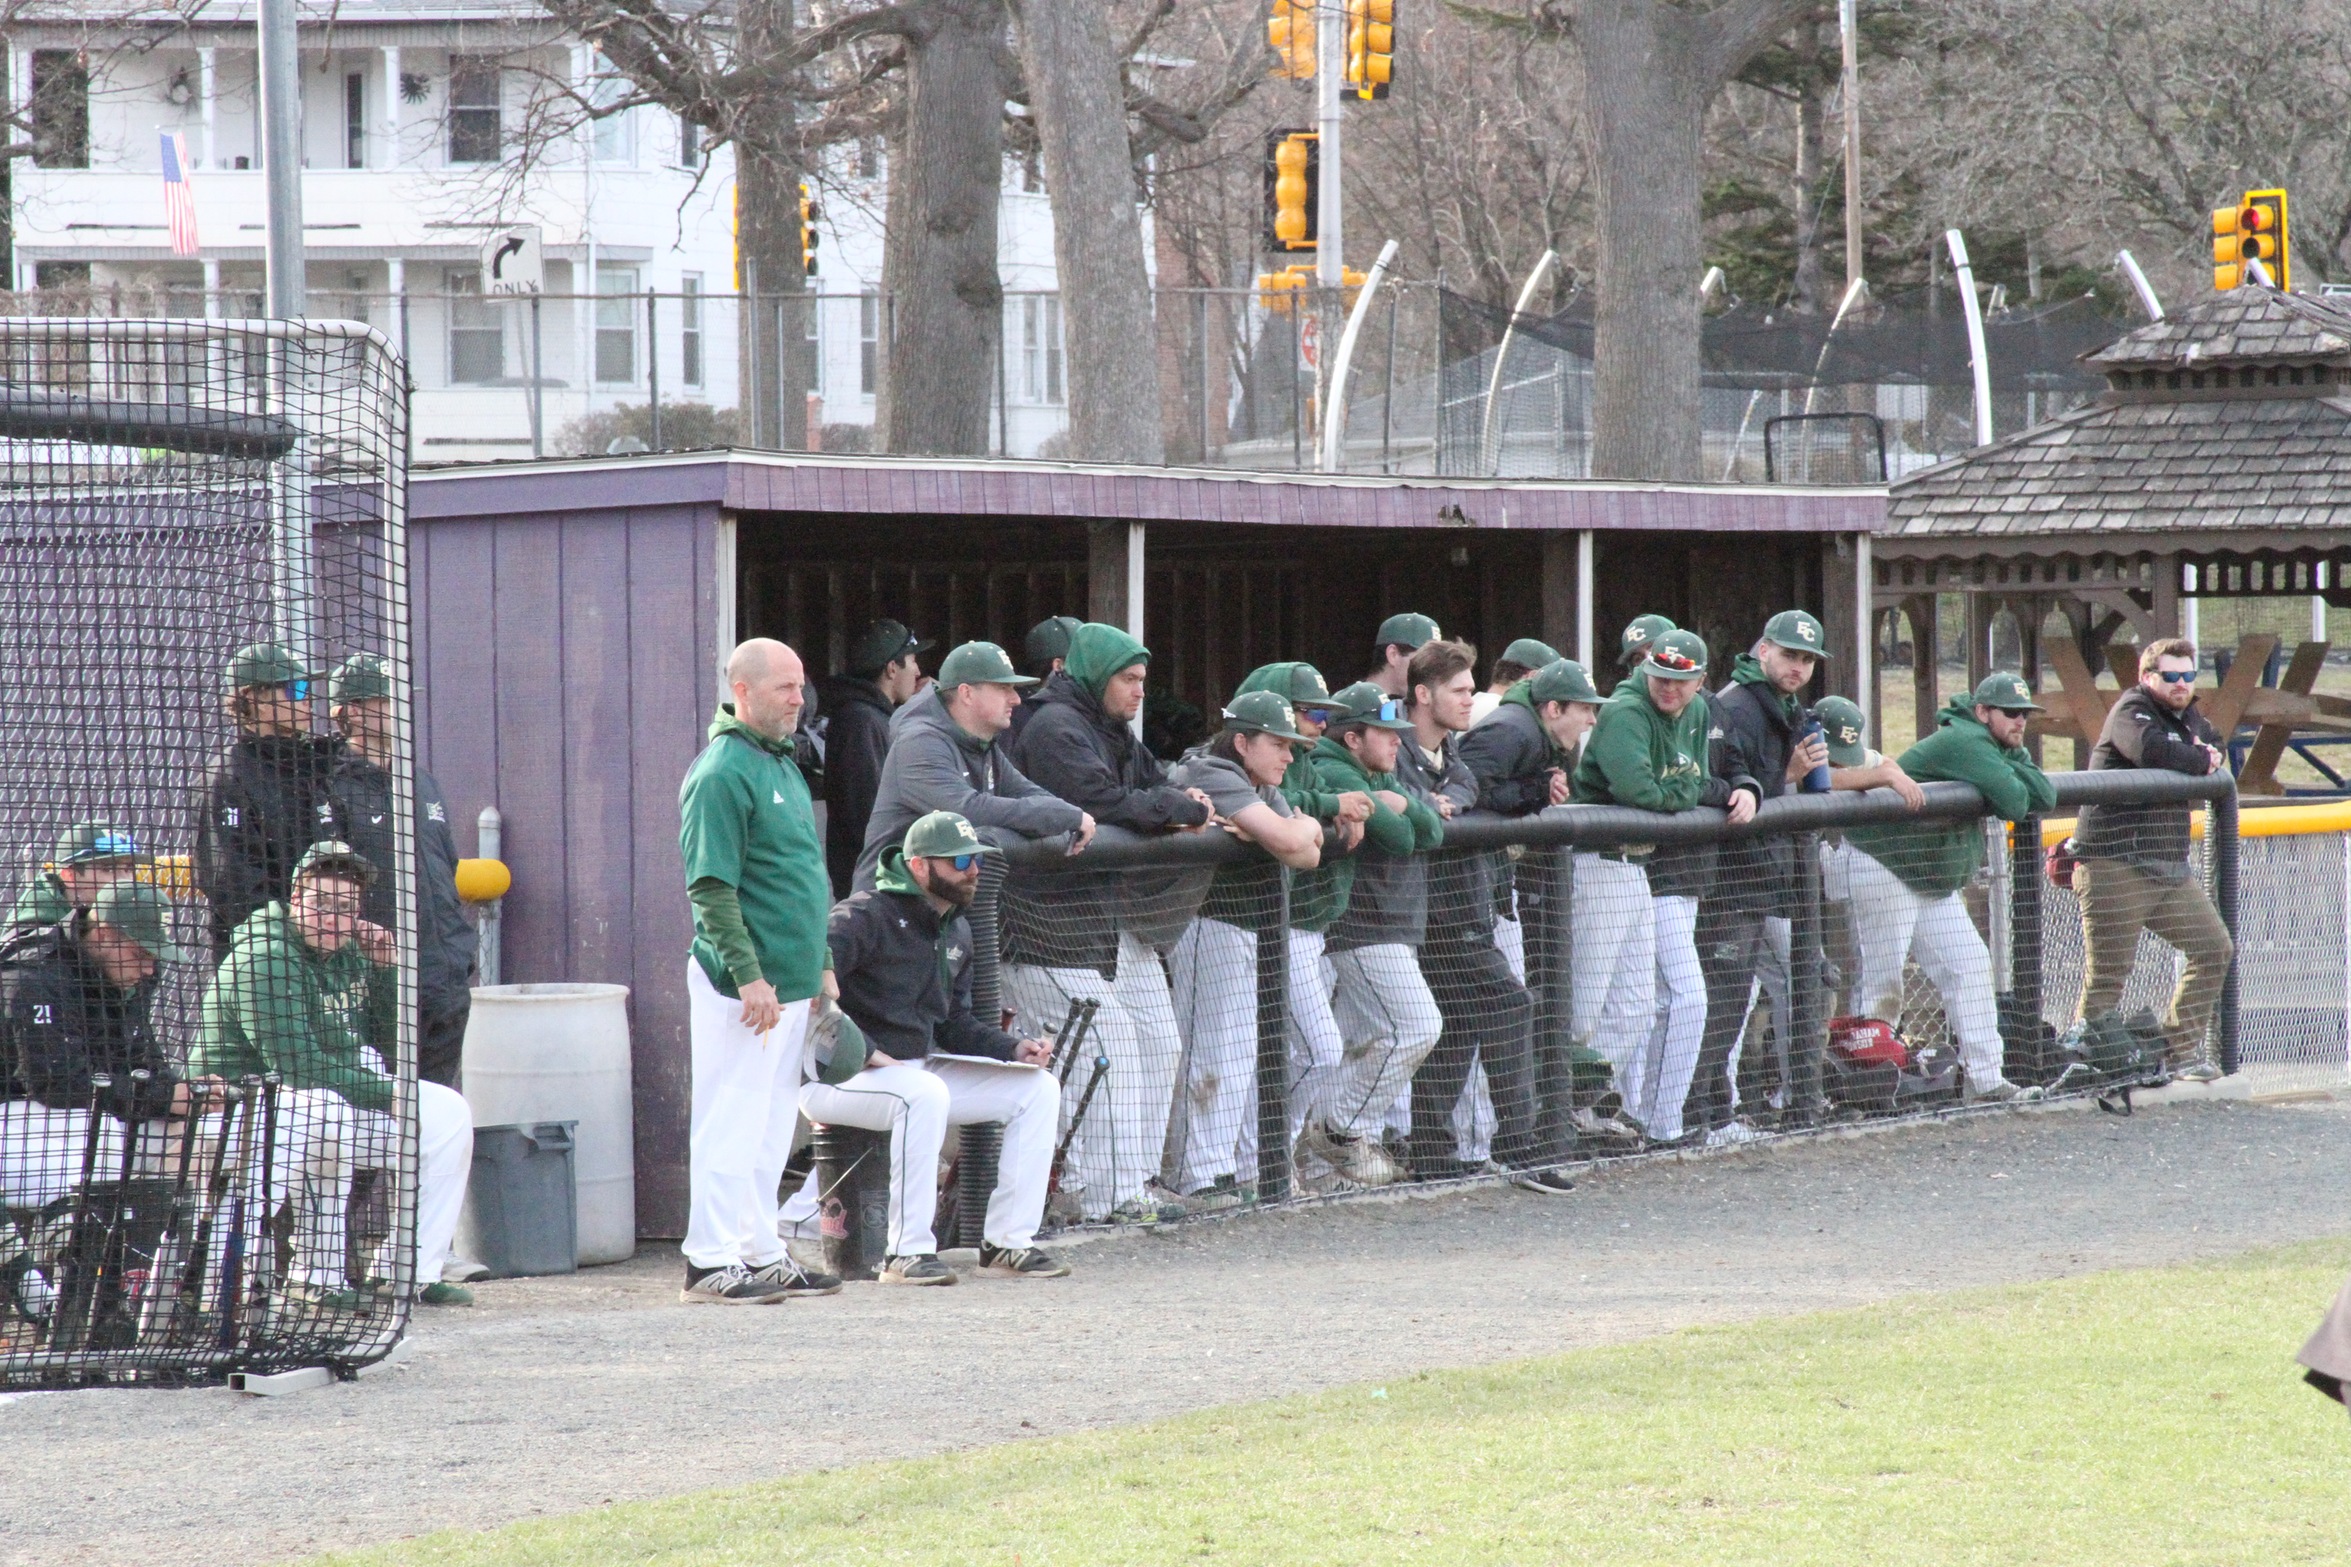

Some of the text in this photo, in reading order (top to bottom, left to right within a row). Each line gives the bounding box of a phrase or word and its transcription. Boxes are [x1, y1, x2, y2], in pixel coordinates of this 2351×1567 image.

[1626, 626, 1646, 642] EC
[1796, 621, 1815, 642] EC
[2013, 682, 2030, 700] EC
[1840, 725, 1859, 744] EC
[33, 1004, 52, 1025] 21
